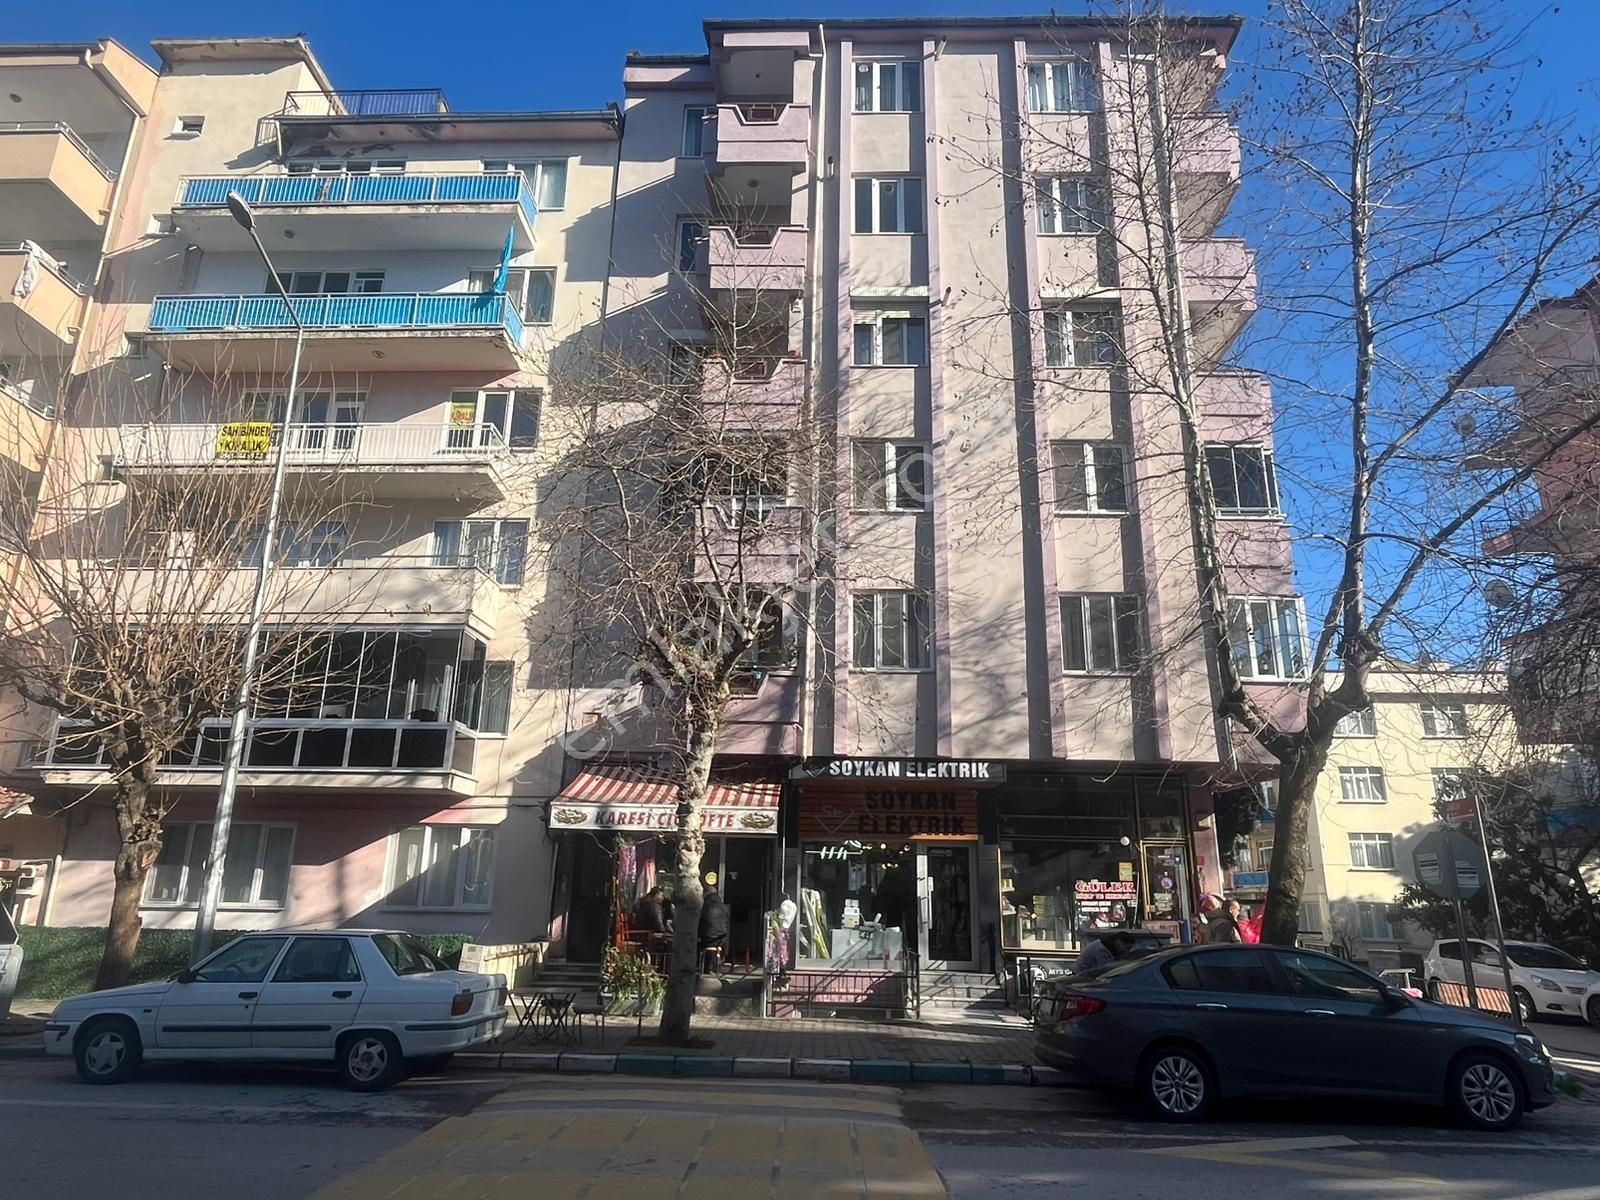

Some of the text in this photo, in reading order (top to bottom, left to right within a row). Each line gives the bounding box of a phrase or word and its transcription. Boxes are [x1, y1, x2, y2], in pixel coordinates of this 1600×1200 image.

[829, 760, 900, 777] SOYKAN
[865, 790, 957, 811] SOYKAN
[696, 809, 734, 828] ÖFTE
